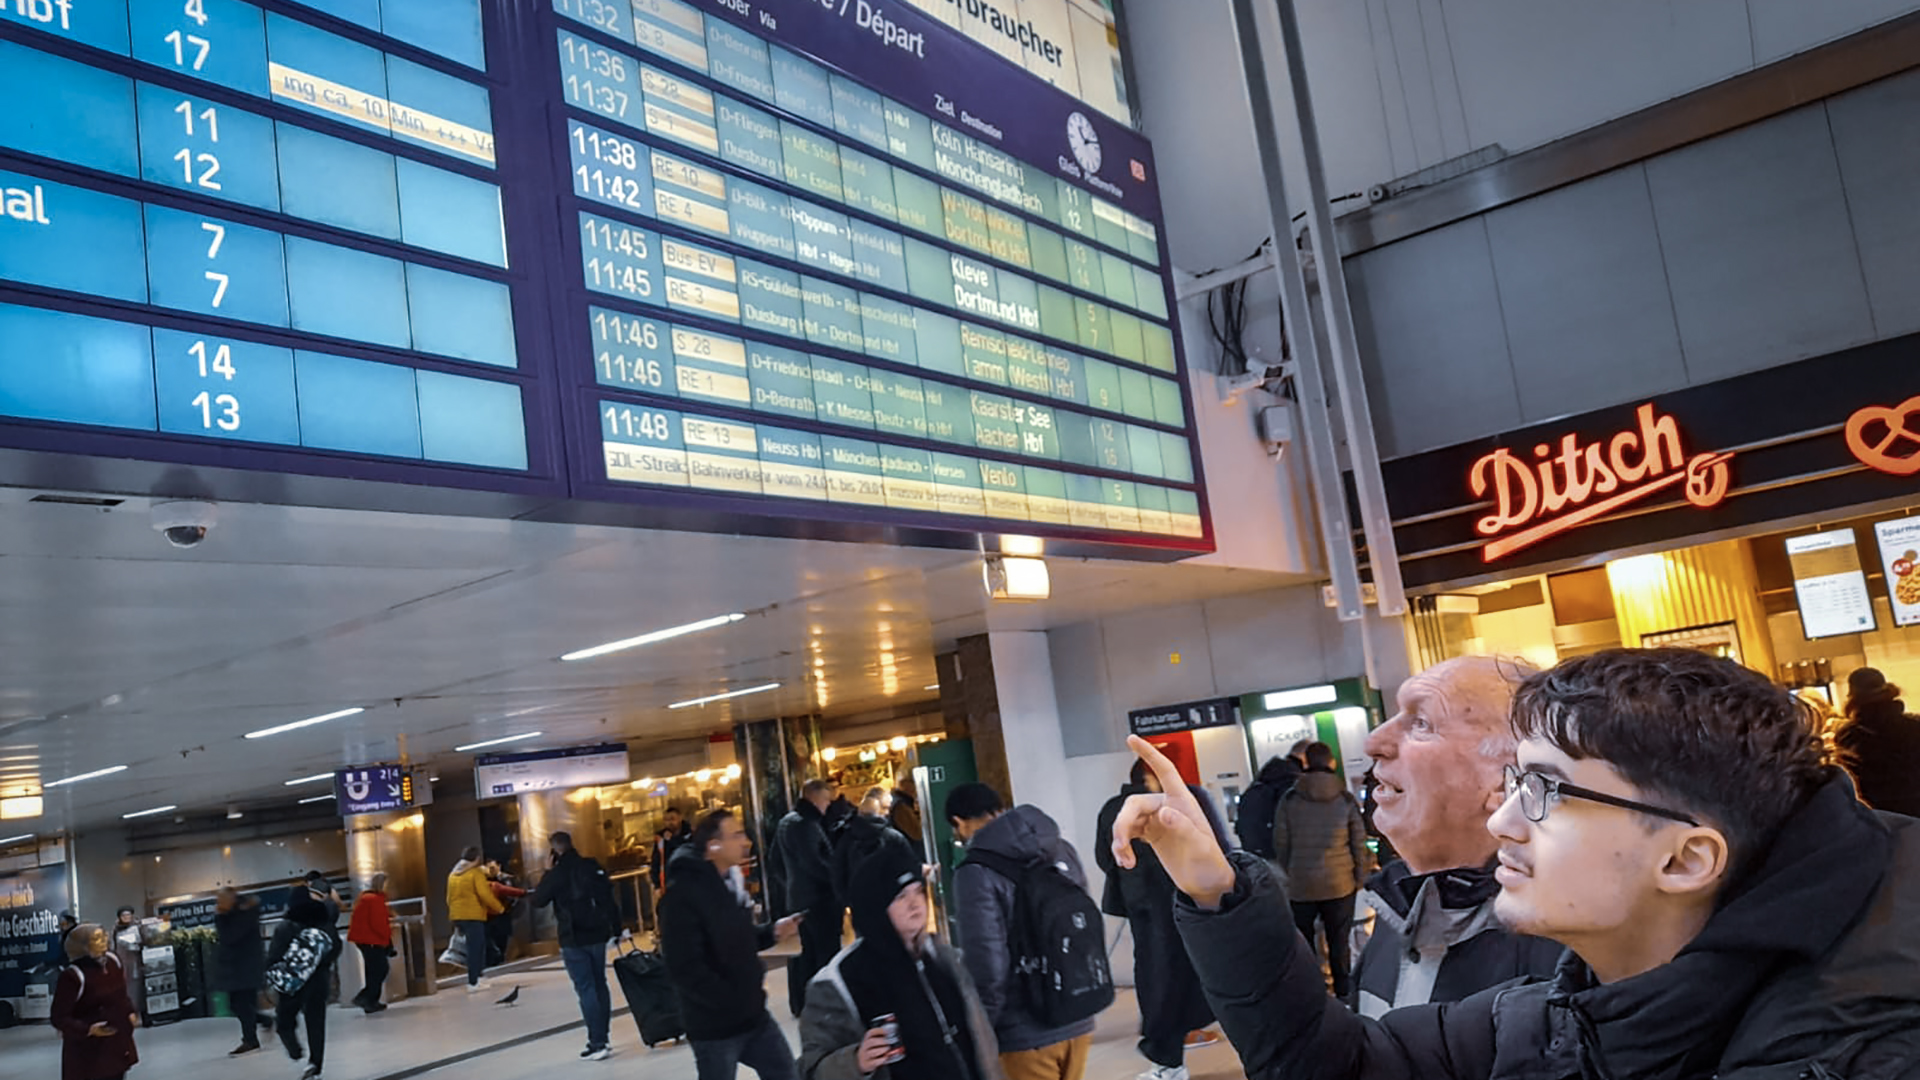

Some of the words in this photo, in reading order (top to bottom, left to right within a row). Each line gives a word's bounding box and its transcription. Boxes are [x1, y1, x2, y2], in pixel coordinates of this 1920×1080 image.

[184, 0, 208, 25] 4
[760, 10, 777, 30] Via
[855, 0, 925, 58] Départ
[164, 30, 211, 71] 17
[563, 37, 626, 82] 11:36
[643, 71, 655, 90] S
[174, 100, 218, 143] 11
[323, 87, 353, 110] ca.
[361, 97, 385, 119] 10
[391, 106, 429, 133] Min.
[567, 75, 629, 118] 11:37
[649, 108, 659, 126] S
[724, 139, 776, 176] Duisburg
[933, 94, 956, 118] Ziel
[960, 110, 1003, 141] Destination
[174, 148, 222, 191] 12
[573, 126, 636, 170] 11:38
[655, 158, 673, 180] RE
[681, 167, 699, 187] 10
[951, 256, 989, 287] Kleve
[1066, 186, 1078, 207] 11
[201, 222, 226, 259] 7
[1069, 209, 1082, 231] 12
[576, 165, 641, 208] 11:42
[658, 193, 677, 214] RE
[684, 201, 694, 218] 4
[798, 241, 818, 260] Hbf
[954, 285, 1017, 322] Dortmund
[1018, 304, 1040, 329] Hbf
[1090, 329, 1099, 348] 7
[585, 219, 648, 259] 11:45
[666, 244, 692, 267] Bus
[698, 251, 717, 274] EV
[205, 271, 229, 308] 7
[588, 257, 651, 297] 11:45
[670, 281, 689, 302] RE
[695, 288, 705, 305] 3
[744, 303, 798, 334] Duisburg
[829, 325, 881, 351] Dortmund
[187, 340, 237, 381] 14
[595, 312, 658, 350] 11:46
[676, 332, 687, 351] S
[693, 337, 712, 357] 28
[970, 392, 1025, 425] Kaarster
[1027, 405, 1052, 429] See
[191, 391, 240, 431] 13
[599, 351, 663, 388] 11:46
[681, 369, 700, 390] RE
[706, 375, 714, 392] 1
[975, 423, 1019, 450] Aachen
[1022, 431, 1045, 456] Hbf
[605, 407, 669, 441] 11:48
[687, 421, 706, 442] RE
[713, 427, 731, 445] 13
[762, 437, 800, 457] Neuss
[802, 443, 823, 461] Hbf
[979, 463, 1017, 488] Venlo
[1469, 402, 1684, 536] Ditsch
[775, 472, 803, 488] vom
[1135, 712, 1180, 727] Fahrkarten
[12, 909, 60, 937] Geschäfte
